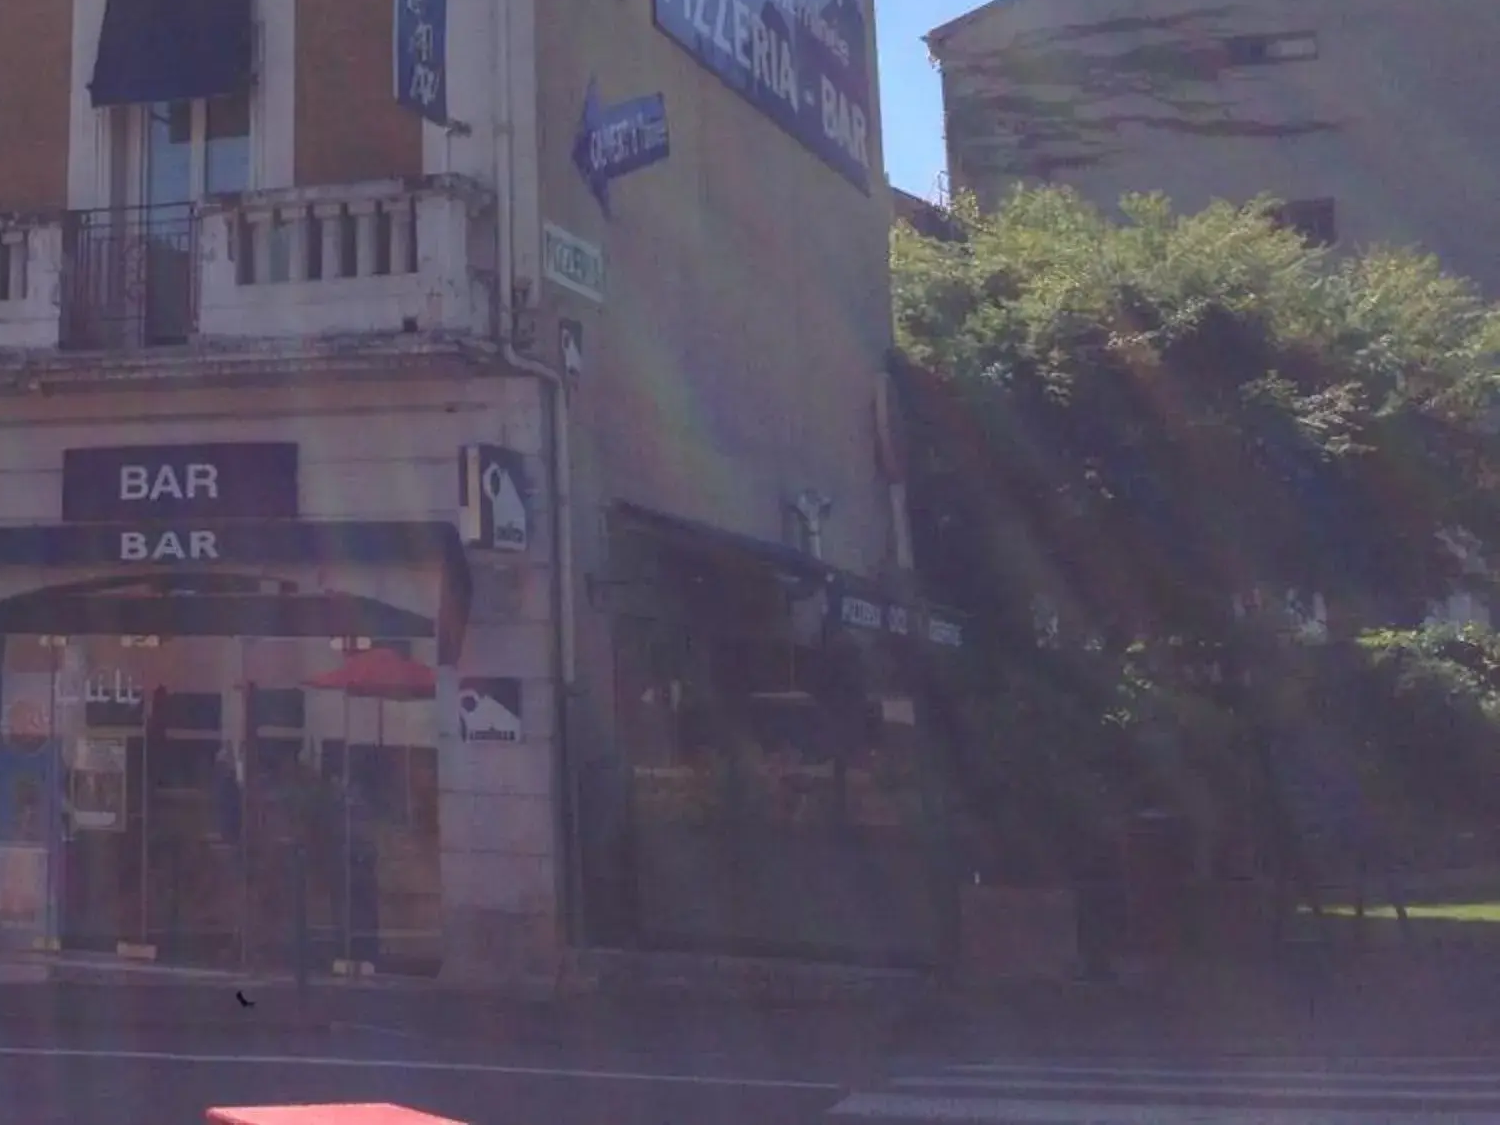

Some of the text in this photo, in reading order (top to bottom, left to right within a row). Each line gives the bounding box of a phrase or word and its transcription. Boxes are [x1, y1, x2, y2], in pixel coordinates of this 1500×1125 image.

[820, 74, 871, 169] BAR
[119, 463, 220, 501] BAR
[119, 531, 220, 560] BAR
